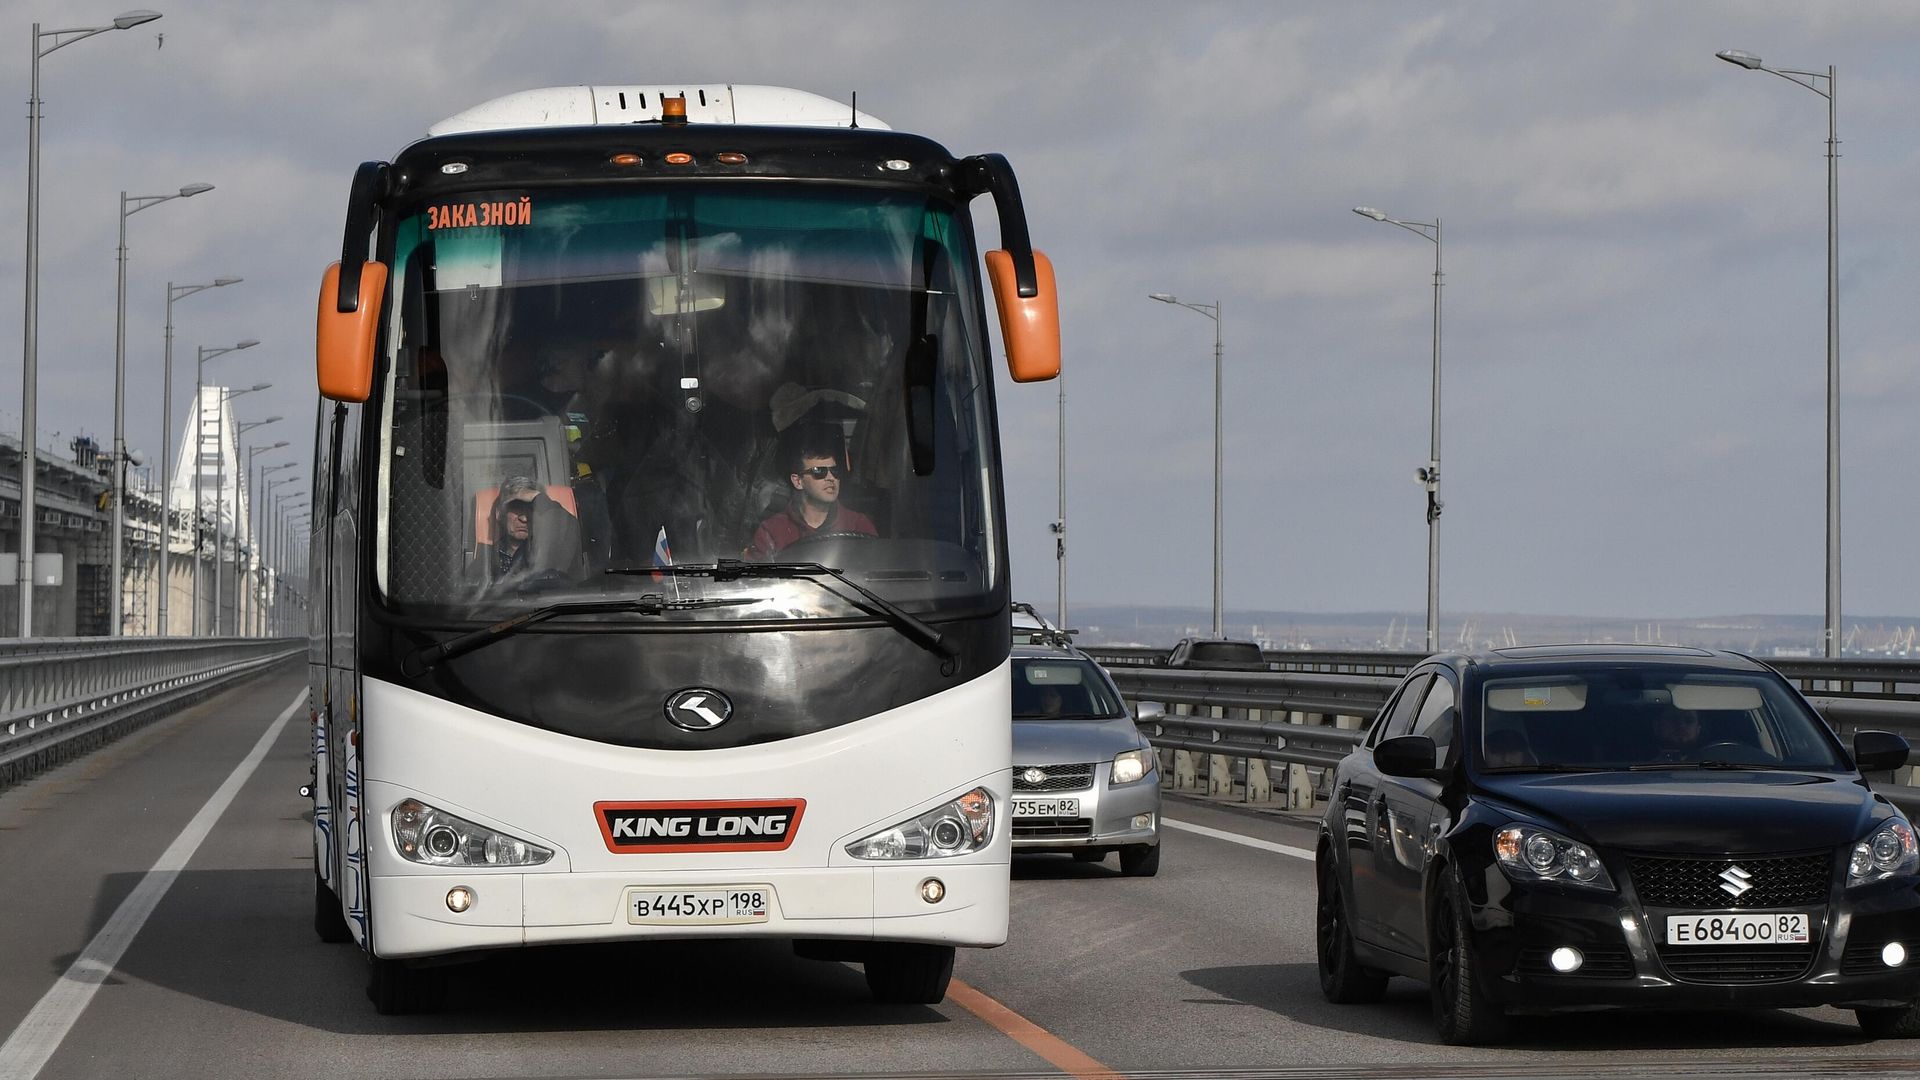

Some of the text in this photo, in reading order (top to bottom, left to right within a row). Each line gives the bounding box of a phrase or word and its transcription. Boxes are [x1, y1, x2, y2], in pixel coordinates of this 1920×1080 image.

[427, 196, 531, 230] ЗАКАЗНОЙ
[1060, 801, 1074, 811] 82
[613, 815, 787, 838] KING LONG
[730, 892, 762, 908] 198
[1779, 916, 1800, 933] 82
